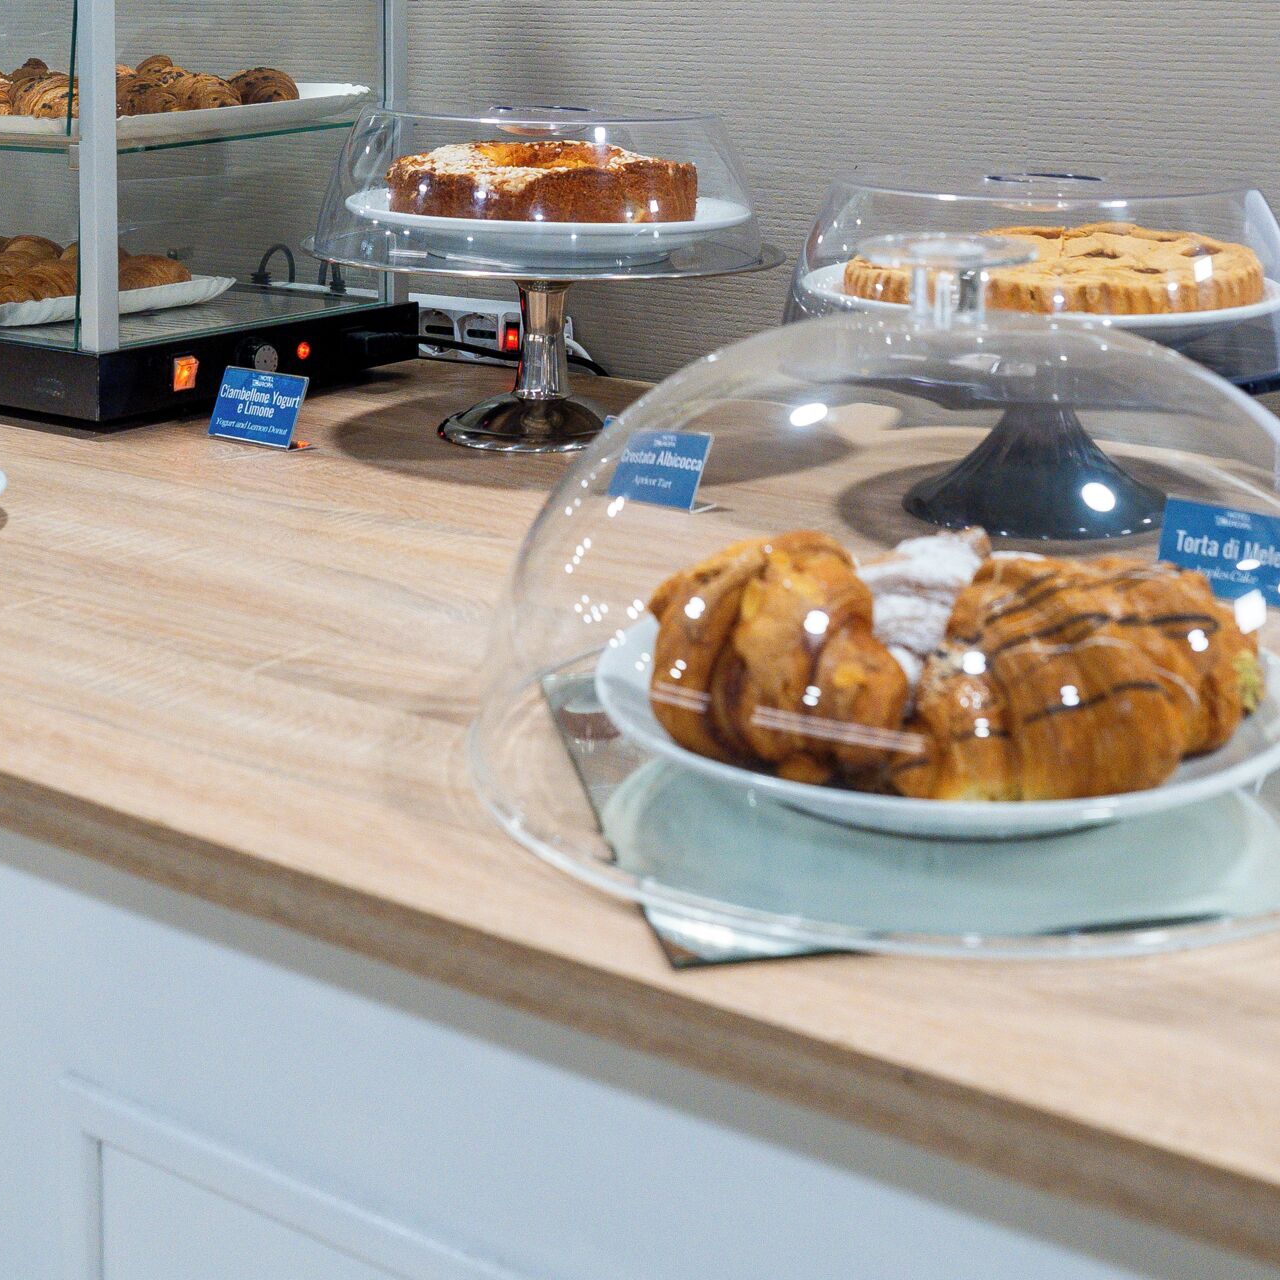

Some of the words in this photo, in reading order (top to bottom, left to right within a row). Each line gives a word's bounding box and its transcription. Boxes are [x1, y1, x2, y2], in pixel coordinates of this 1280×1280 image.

[220, 383, 271, 404] Ciambellone
[272, 390, 300, 410] Yogurt
[237, 402, 244, 414] e
[244, 400, 275, 419] Limone
[215, 417, 236, 428] Yogurt
[235, 420, 247, 429] and
[246, 420, 269, 432] Lemon
[268, 425, 288, 436] Donut
[656, 450, 703, 471] Albicocca
[1176, 529, 1219, 558] Torta
[1222, 537, 1240, 561] di
